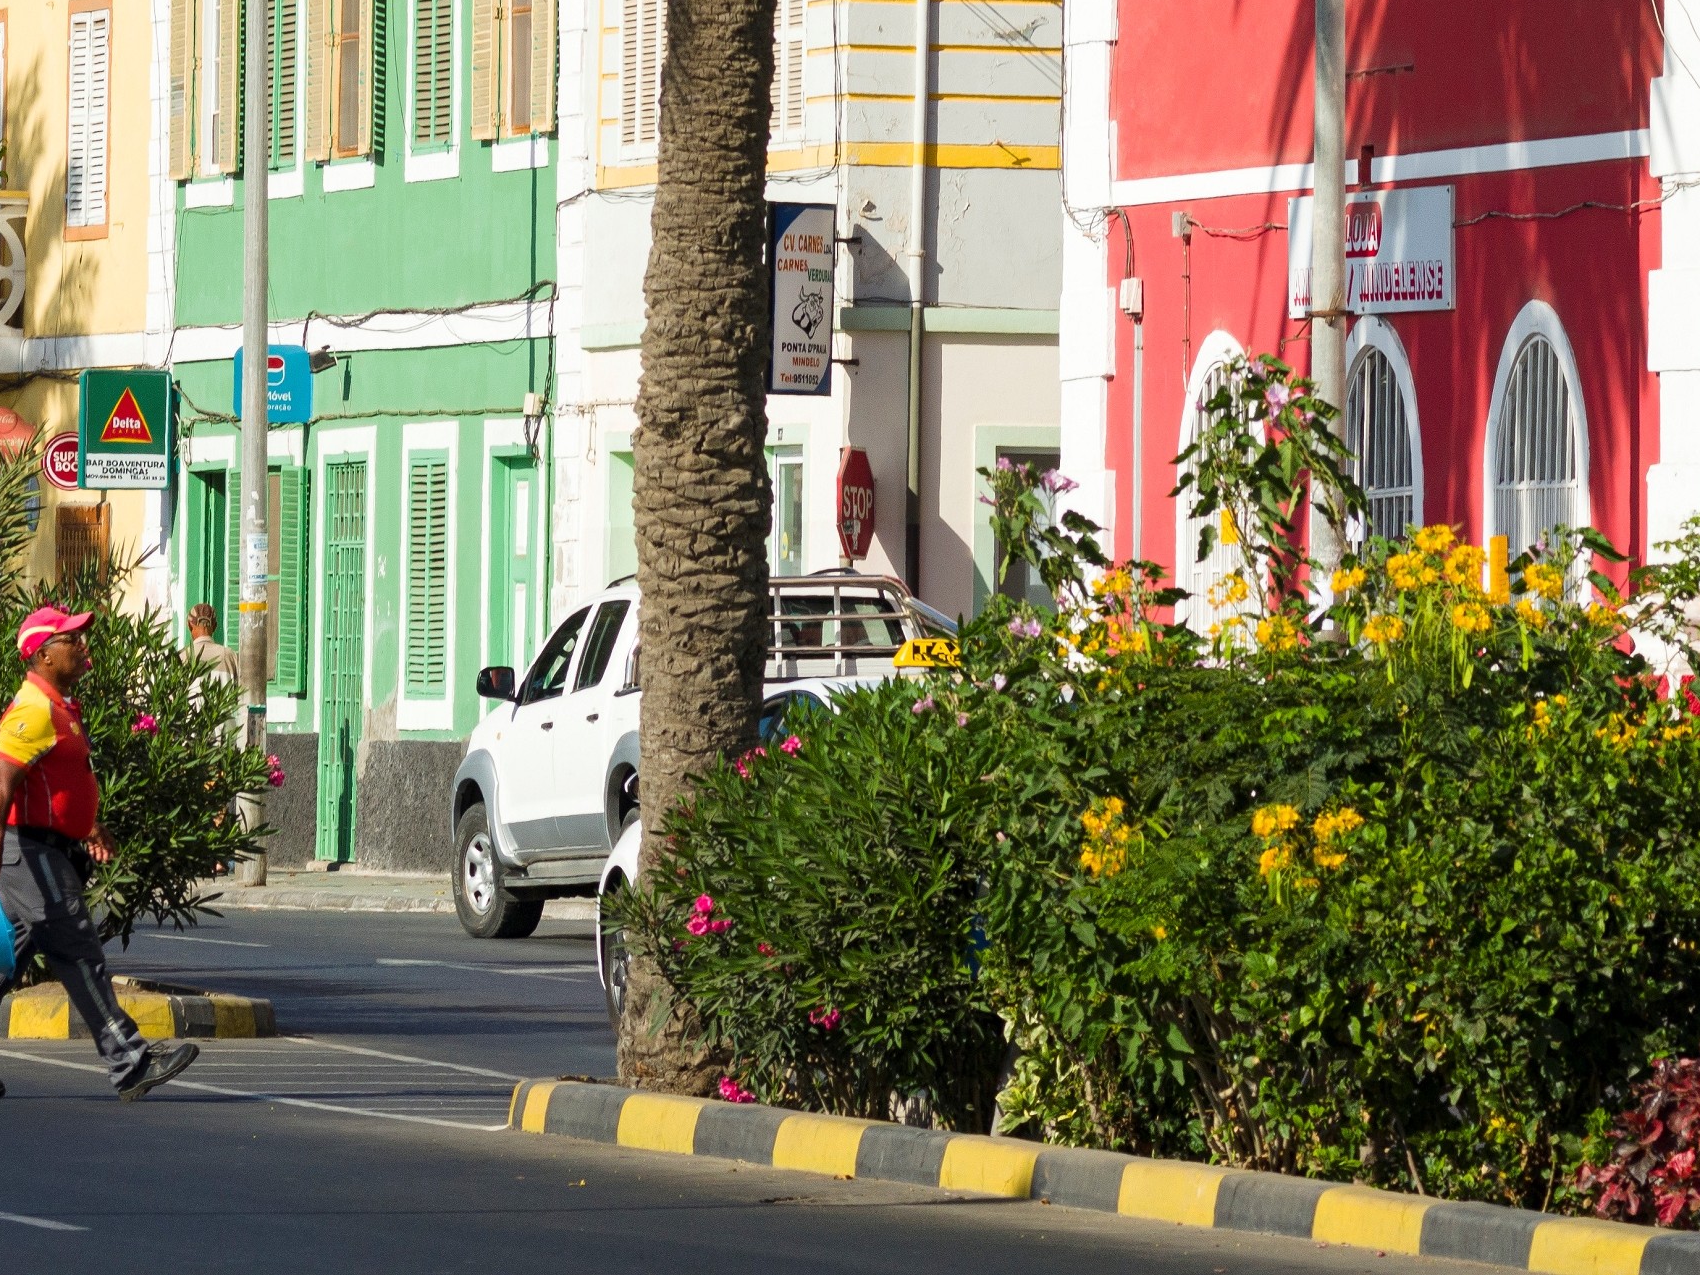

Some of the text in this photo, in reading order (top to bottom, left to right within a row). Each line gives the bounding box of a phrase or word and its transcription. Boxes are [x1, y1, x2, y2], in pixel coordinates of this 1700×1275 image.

[798, 234, 823, 254] CARNES
[778, 258, 808, 272] CARNES
[1359, 259, 1443, 303] MINDELENSE
[782, 342, 806, 353] PONTA
[793, 356, 819, 367] MINDELO
[112, 416, 141, 429] Delta
[55, 463, 78, 472] BOC
[106, 460, 165, 468] BOAVENTURA
[102, 467, 149, 475] DOMINGAS
[843, 485, 872, 519] STOP
[913, 642, 960, 655] TAX
